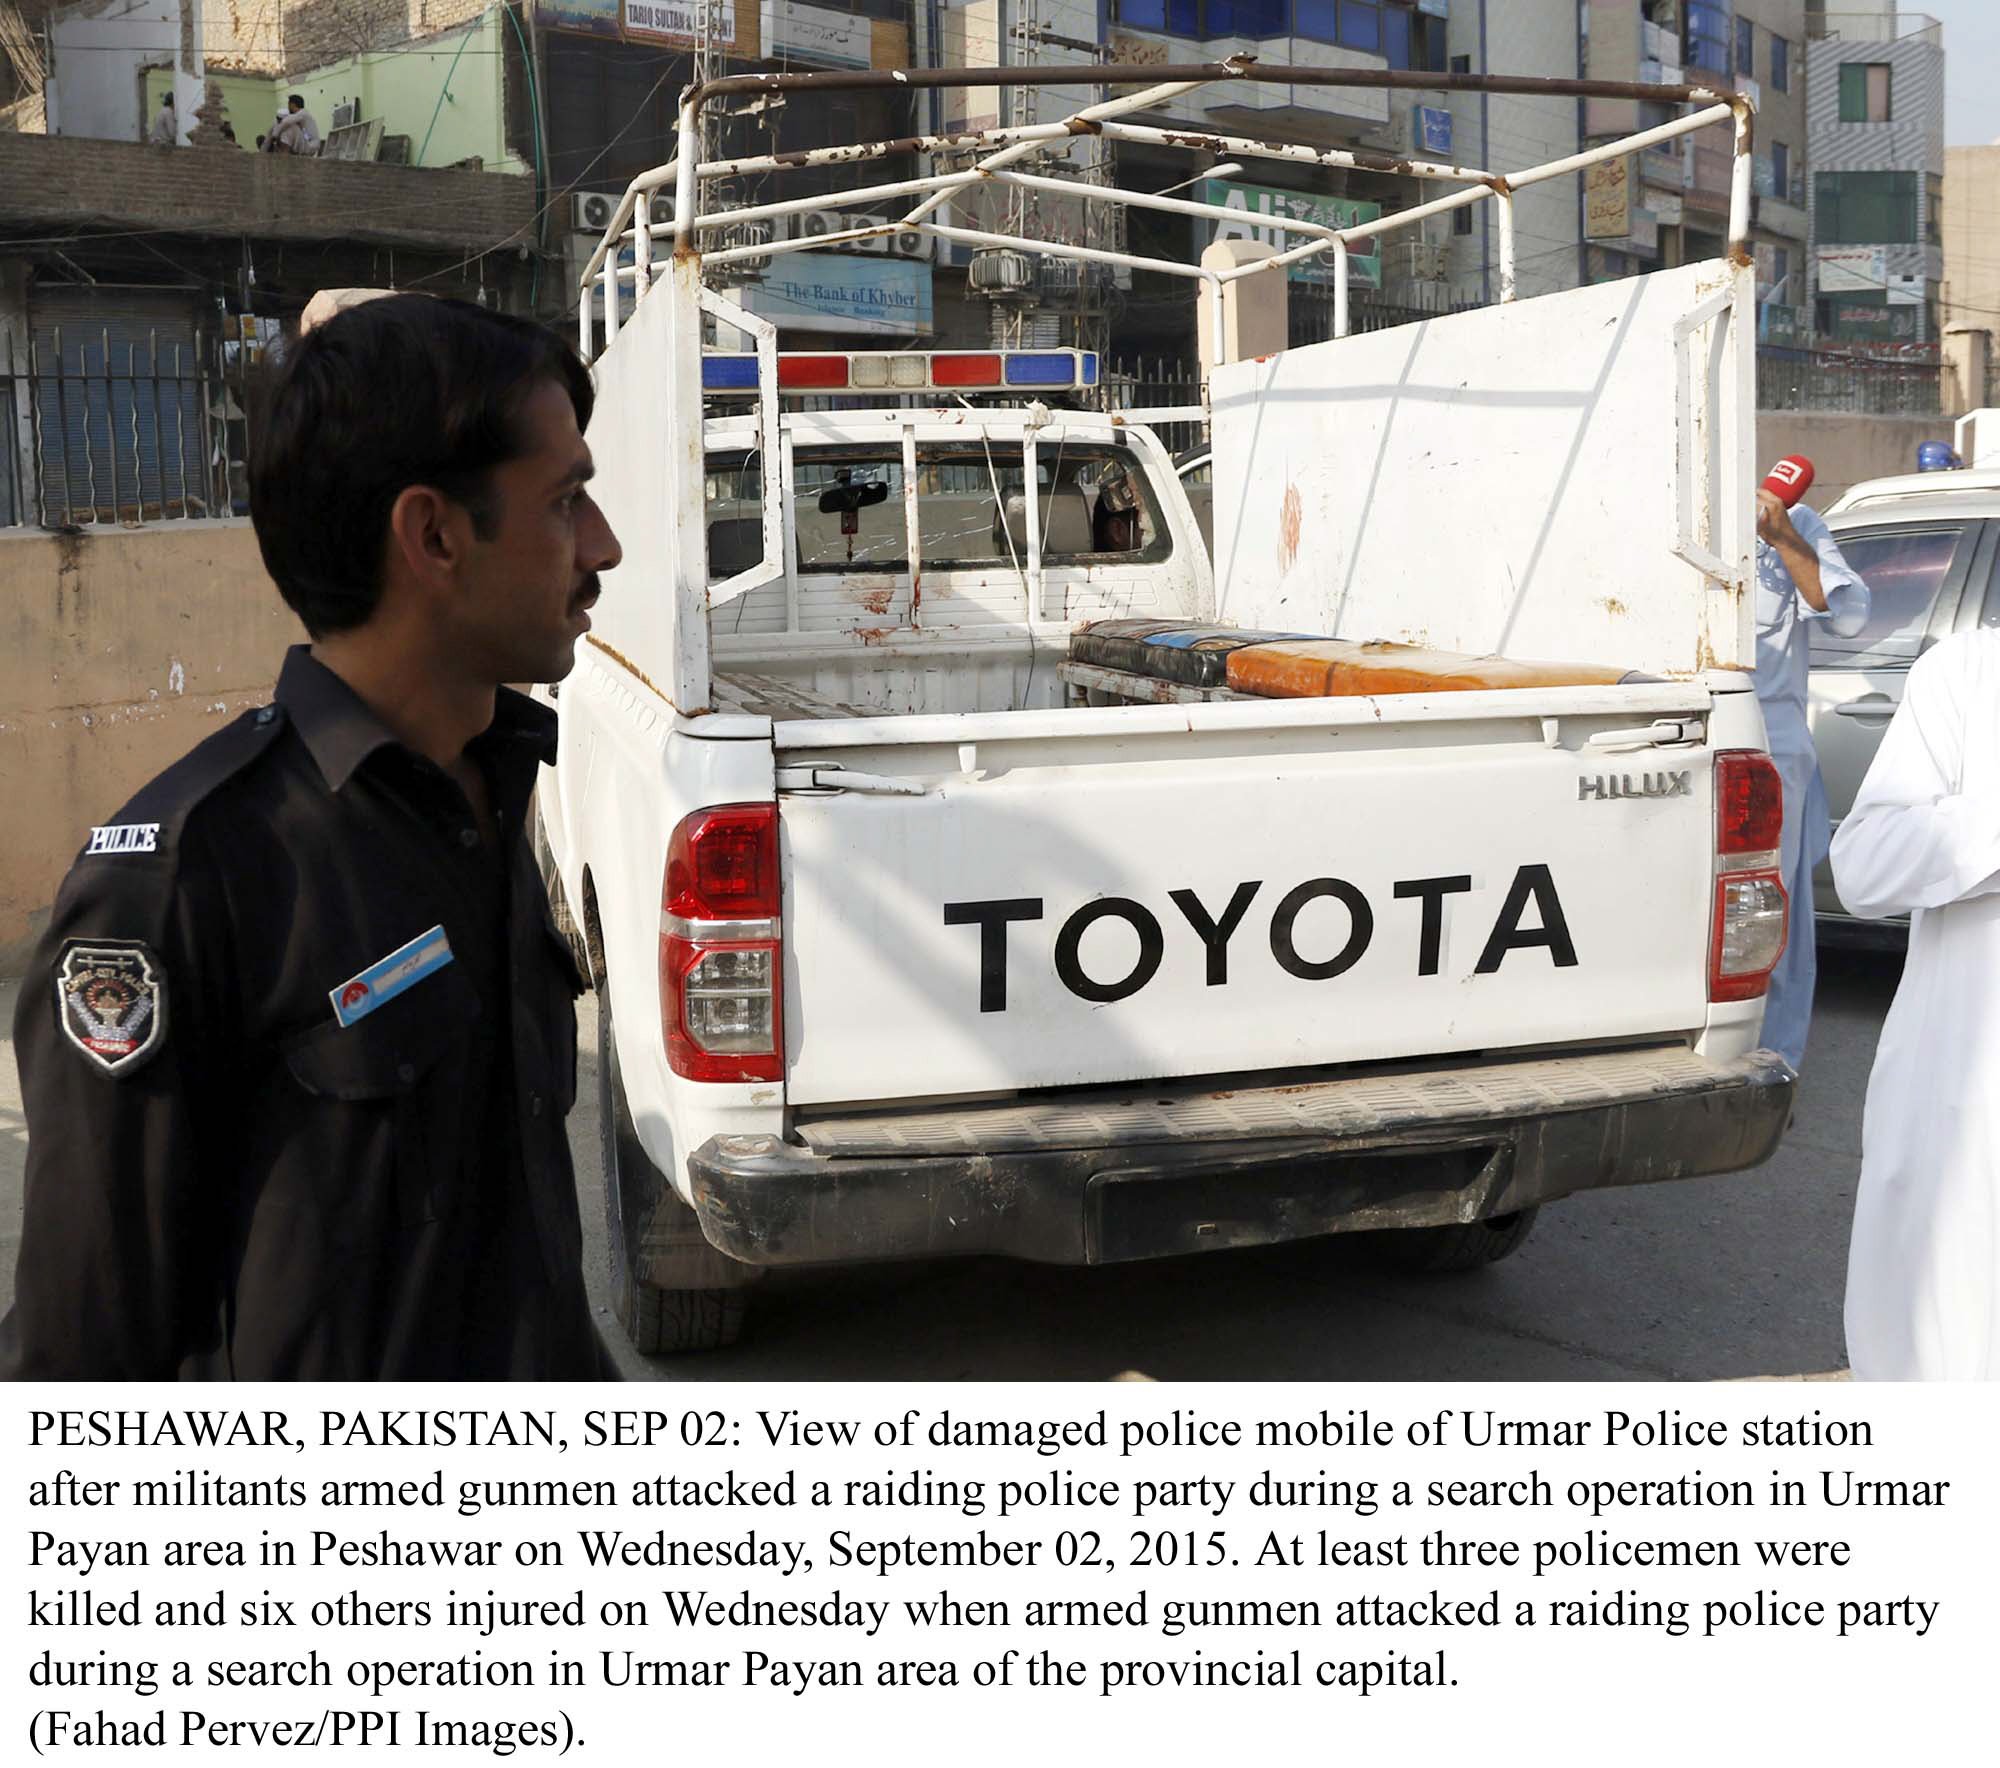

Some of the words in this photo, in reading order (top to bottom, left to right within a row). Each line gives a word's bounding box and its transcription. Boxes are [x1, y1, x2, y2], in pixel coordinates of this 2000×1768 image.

[628, 5, 653, 27] TARIQ
[655, 6, 685, 31] SULTAN
[686, 17, 693, 31] &
[1213, 189, 1286, 253] Ali
[783, 282, 810, 299] The
[814, 284, 848, 301] Bank
[852, 287, 866, 303] of
[869, 289, 916, 307] Khyber
[1577, 770, 1691, 801] HILUX
[86, 823, 160, 855] POLICE
[944, 864, 1578, 1013] TOYOTA
